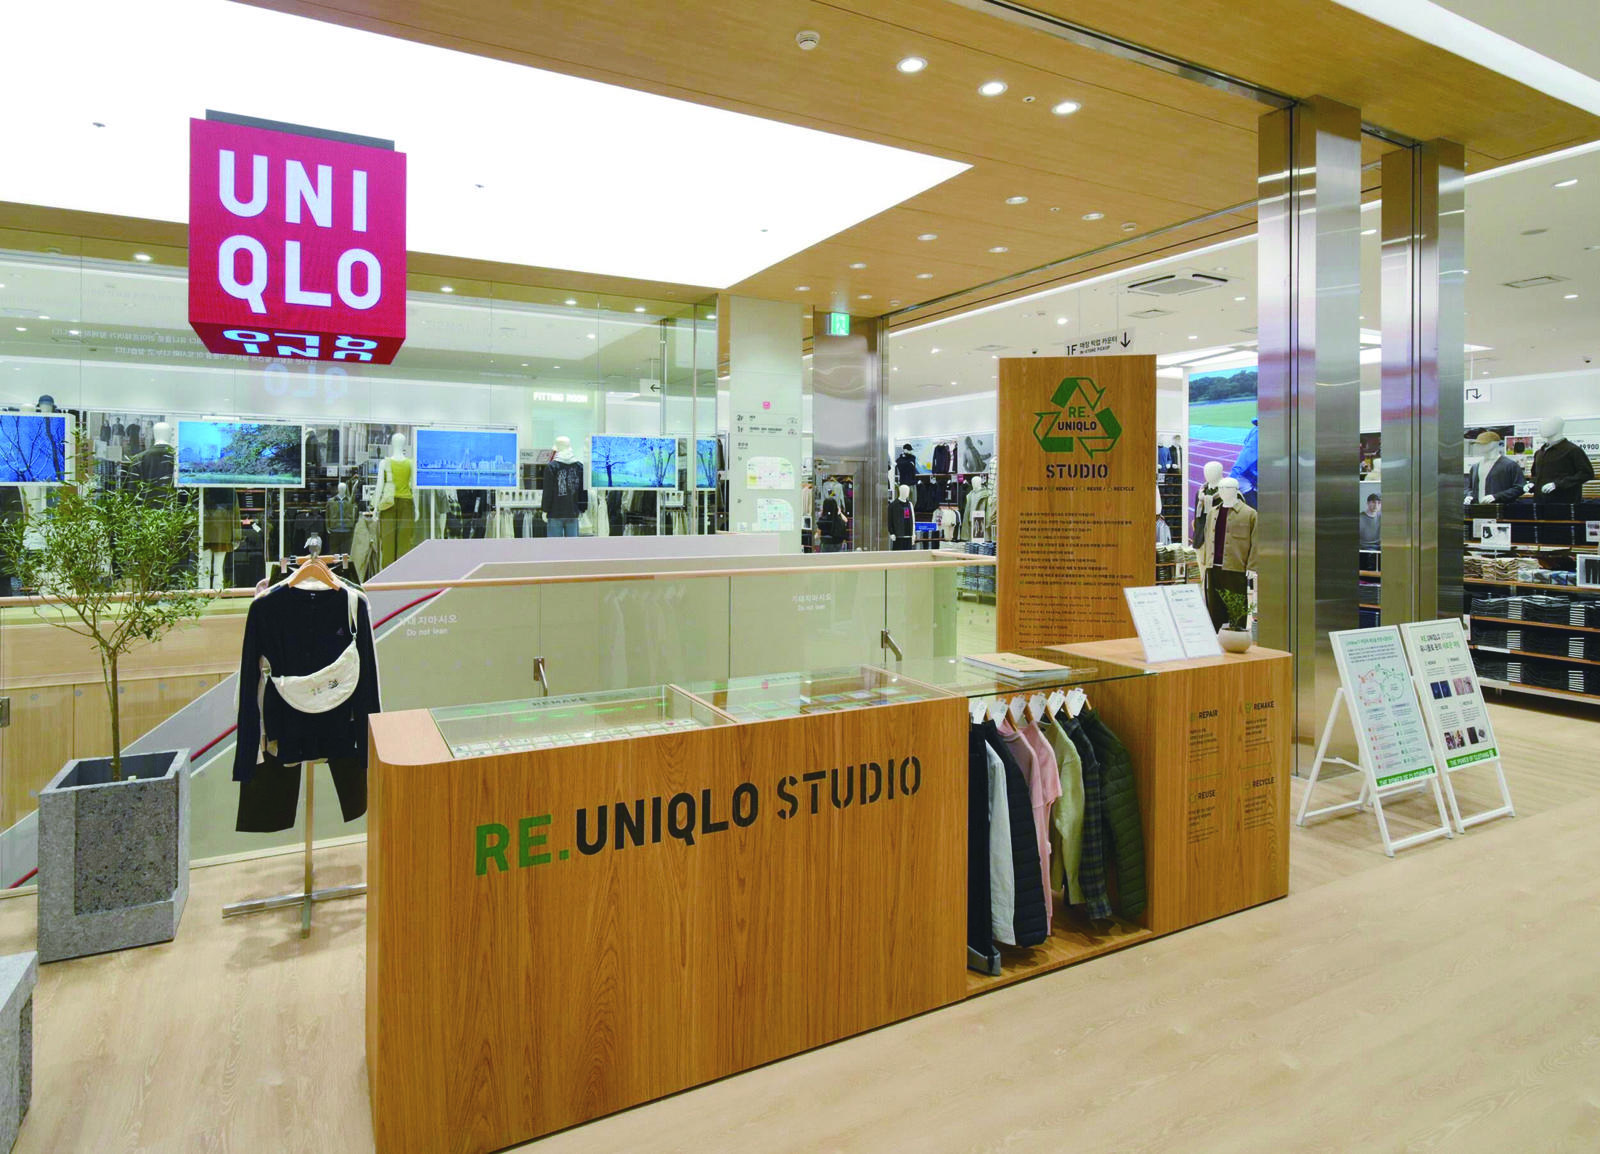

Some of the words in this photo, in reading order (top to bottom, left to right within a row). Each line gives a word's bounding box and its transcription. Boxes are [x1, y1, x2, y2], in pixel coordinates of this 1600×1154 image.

[218, 149, 367, 232] UNI
[218, 235, 382, 314] QLO
[1067, 344, 1078, 356] 1F
[1068, 406, 1091, 418] RE.
[1057, 421, 1097, 433] UNIQLO
[1045, 464, 1108, 479] STUDIO
[1253, 700, 1275, 711] REMAKE
[1198, 709, 1218, 719] REPAIR
[776, 756, 922, 820] STUDIO
[1252, 776, 1276, 788] RECYCLE
[1198, 789, 1216, 800] REUSE
